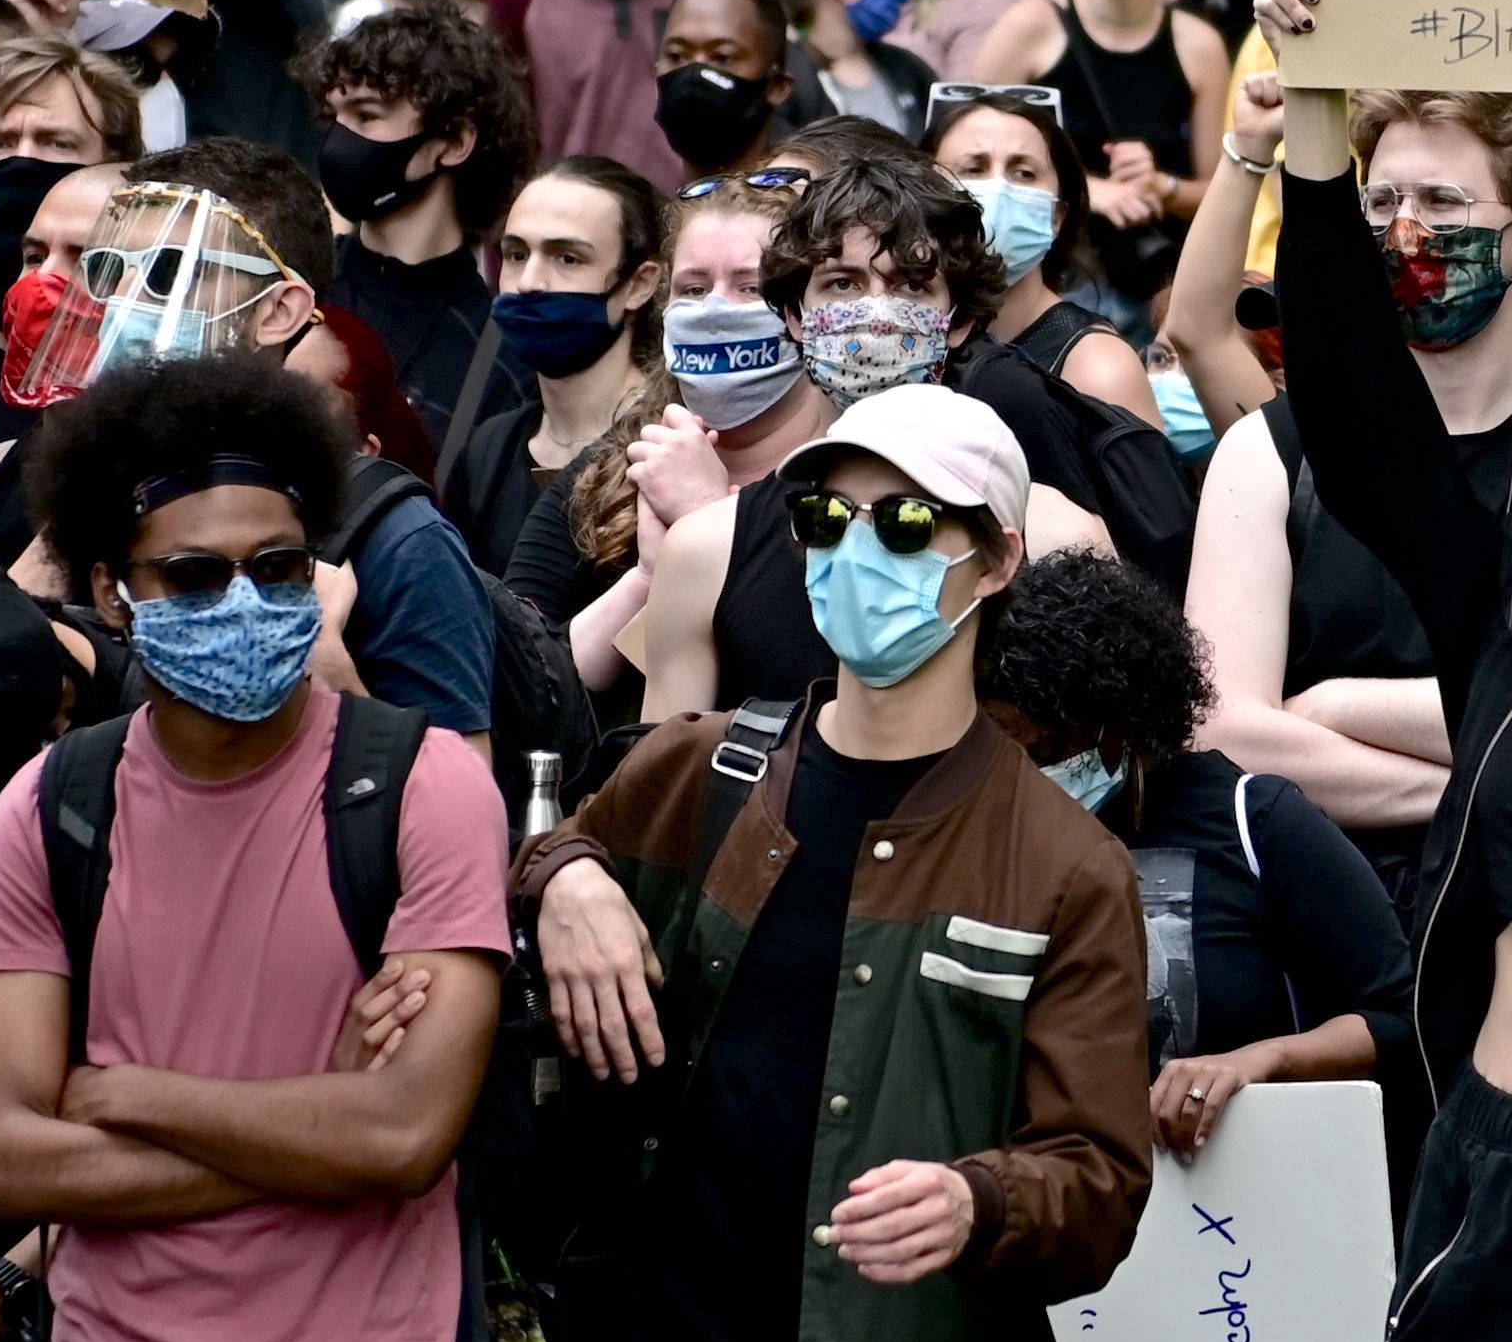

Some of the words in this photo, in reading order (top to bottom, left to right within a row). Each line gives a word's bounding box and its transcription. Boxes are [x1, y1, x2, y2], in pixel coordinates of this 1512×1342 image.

[673, 348, 718, 372] New
[724, 340, 777, 369] York
[1191, 1202, 1237, 1246] X
